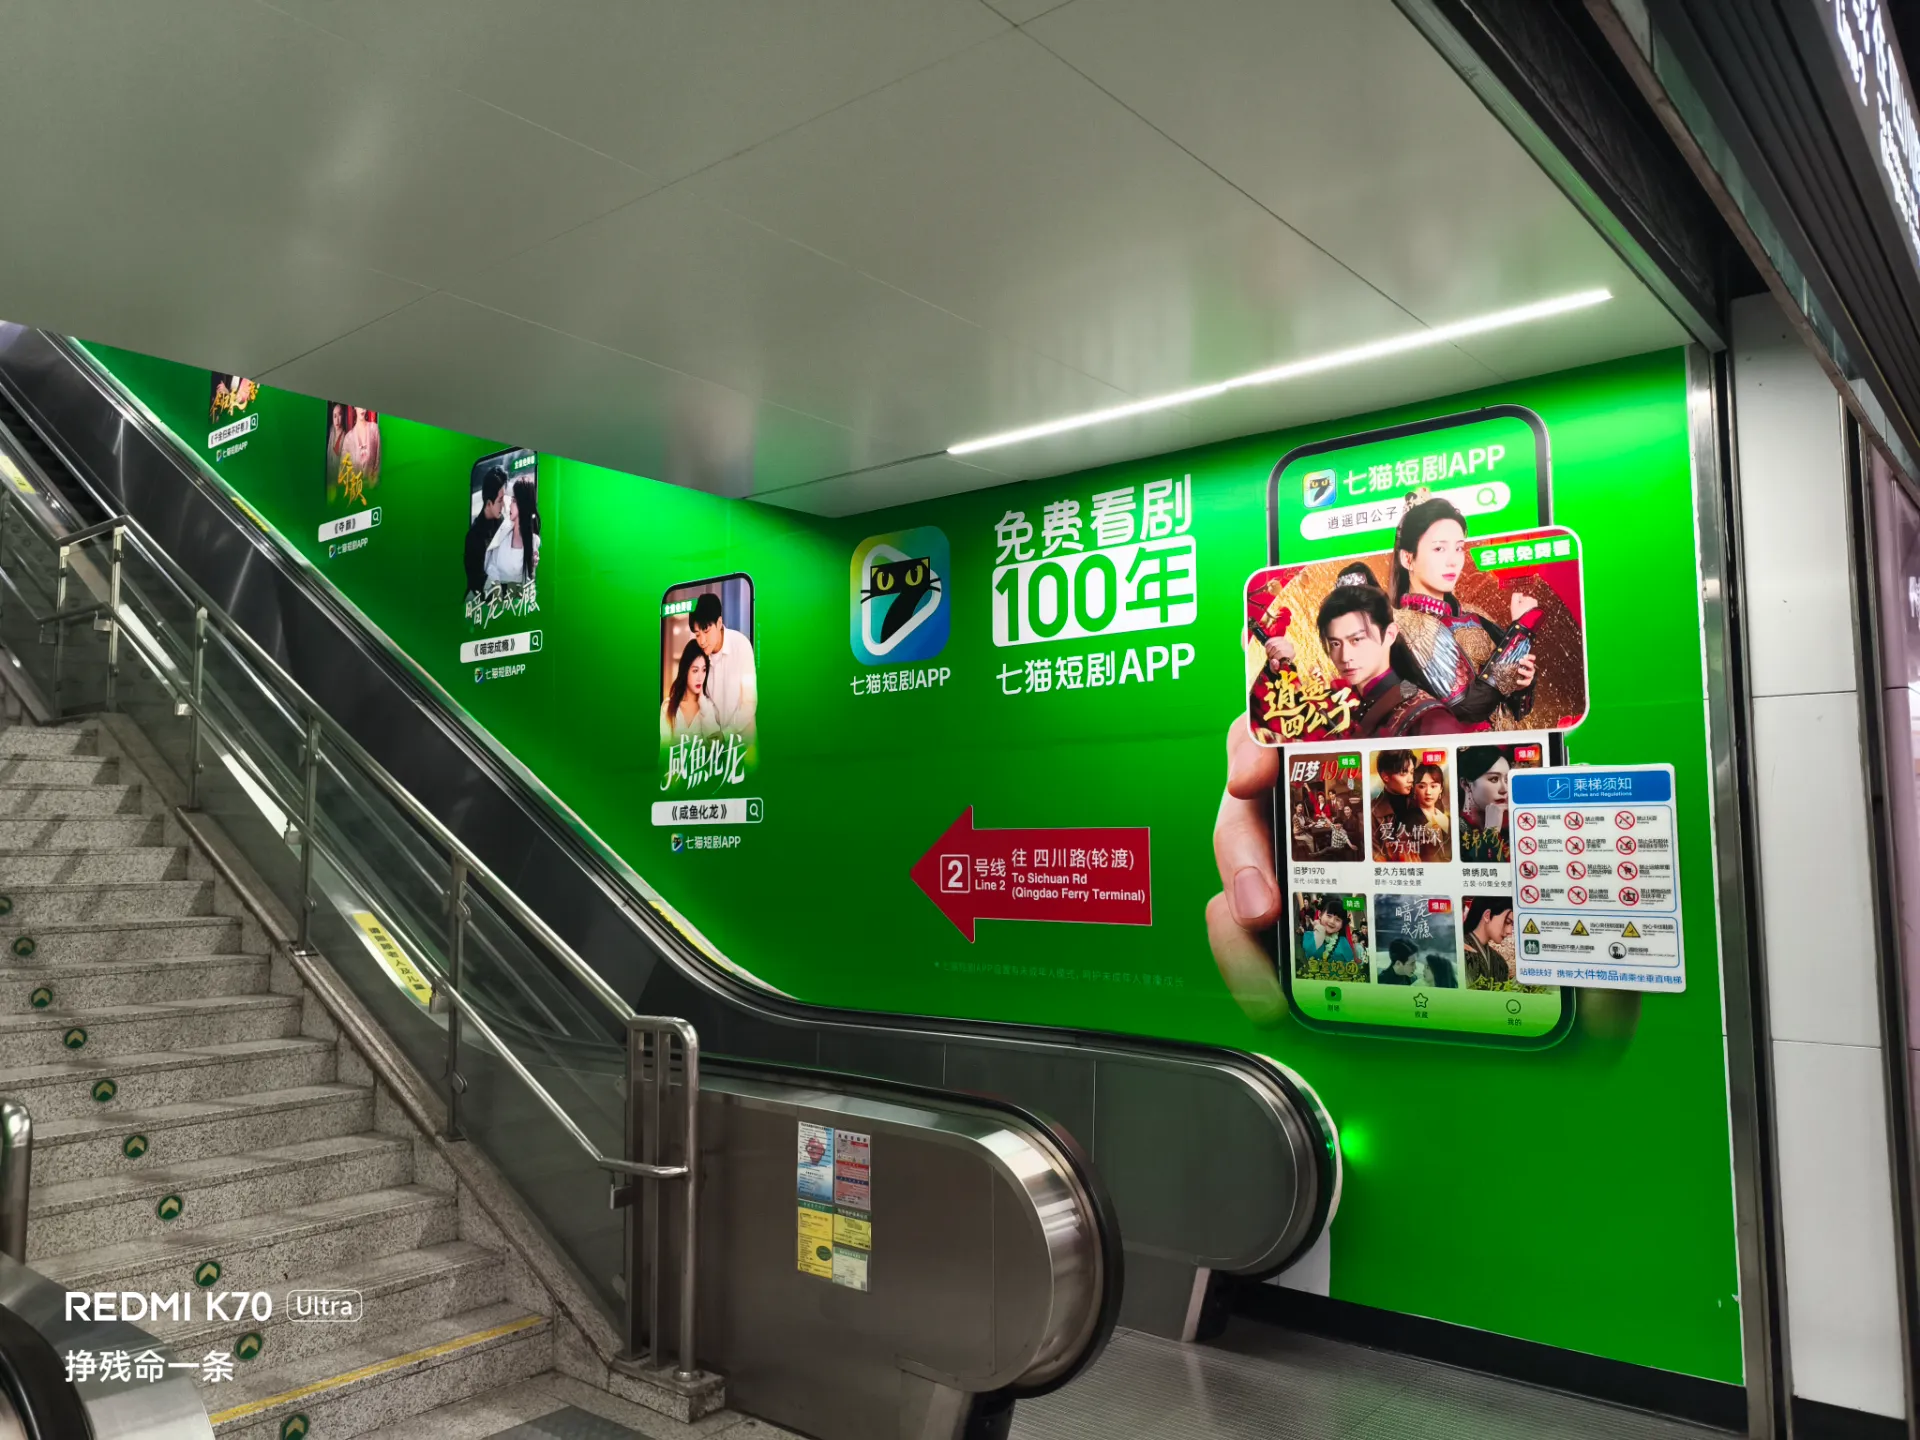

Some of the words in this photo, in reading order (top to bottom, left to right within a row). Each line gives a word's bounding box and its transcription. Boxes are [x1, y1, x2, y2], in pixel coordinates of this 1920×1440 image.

[1343, 445, 1505, 496] 七猫短剧APP
[994, 474, 1192, 565] 免费看剧
[1327, 506, 1398, 531] 逍遥四公子
[995, 546, 1194, 642] 100年
[485, 664, 526, 680] 七猫短剧APP
[996, 642, 1195, 695] 七猫短剧APP
[850, 667, 951, 696] 七猫短剧APP
[1574, 777, 1632, 791] 乘梯须知
[1601, 790, 1633, 798] Regulations
[671, 804, 728, 821] 《咸鱼化龙》
[686, 835, 741, 849] 七猫短剧APP
[1011, 848, 1027, 868] 往
[1034, 848, 1134, 870] 四川路(轮渡)
[947, 860, 963, 888] 2
[974, 858, 1007, 878] 号线
[1293, 866, 1325, 875] 旧梦1970
[1374, 867, 1424, 876] 爱久方知情深
[1462, 868, 1498, 877] 锦绣凤鸣
[975, 879, 997, 891] Line
[999, 879, 1006, 891] 2
[1011, 873, 1025, 884] To
[1027, 873, 1070, 885] Sichuan
[1072, 873, 1088, 885] Rd
[1011, 887, 1059, 900] (Qingdao
[1061, 887, 1090, 902] Ferry
[1091, 888, 1145, 903] Terminal)
[1519, 967, 1552, 977] 站稳扶好
[1556, 968, 1683, 985] 携带大件物品请乘坐垂直电梯
[1507, 1018, 1522, 1027] 我的
